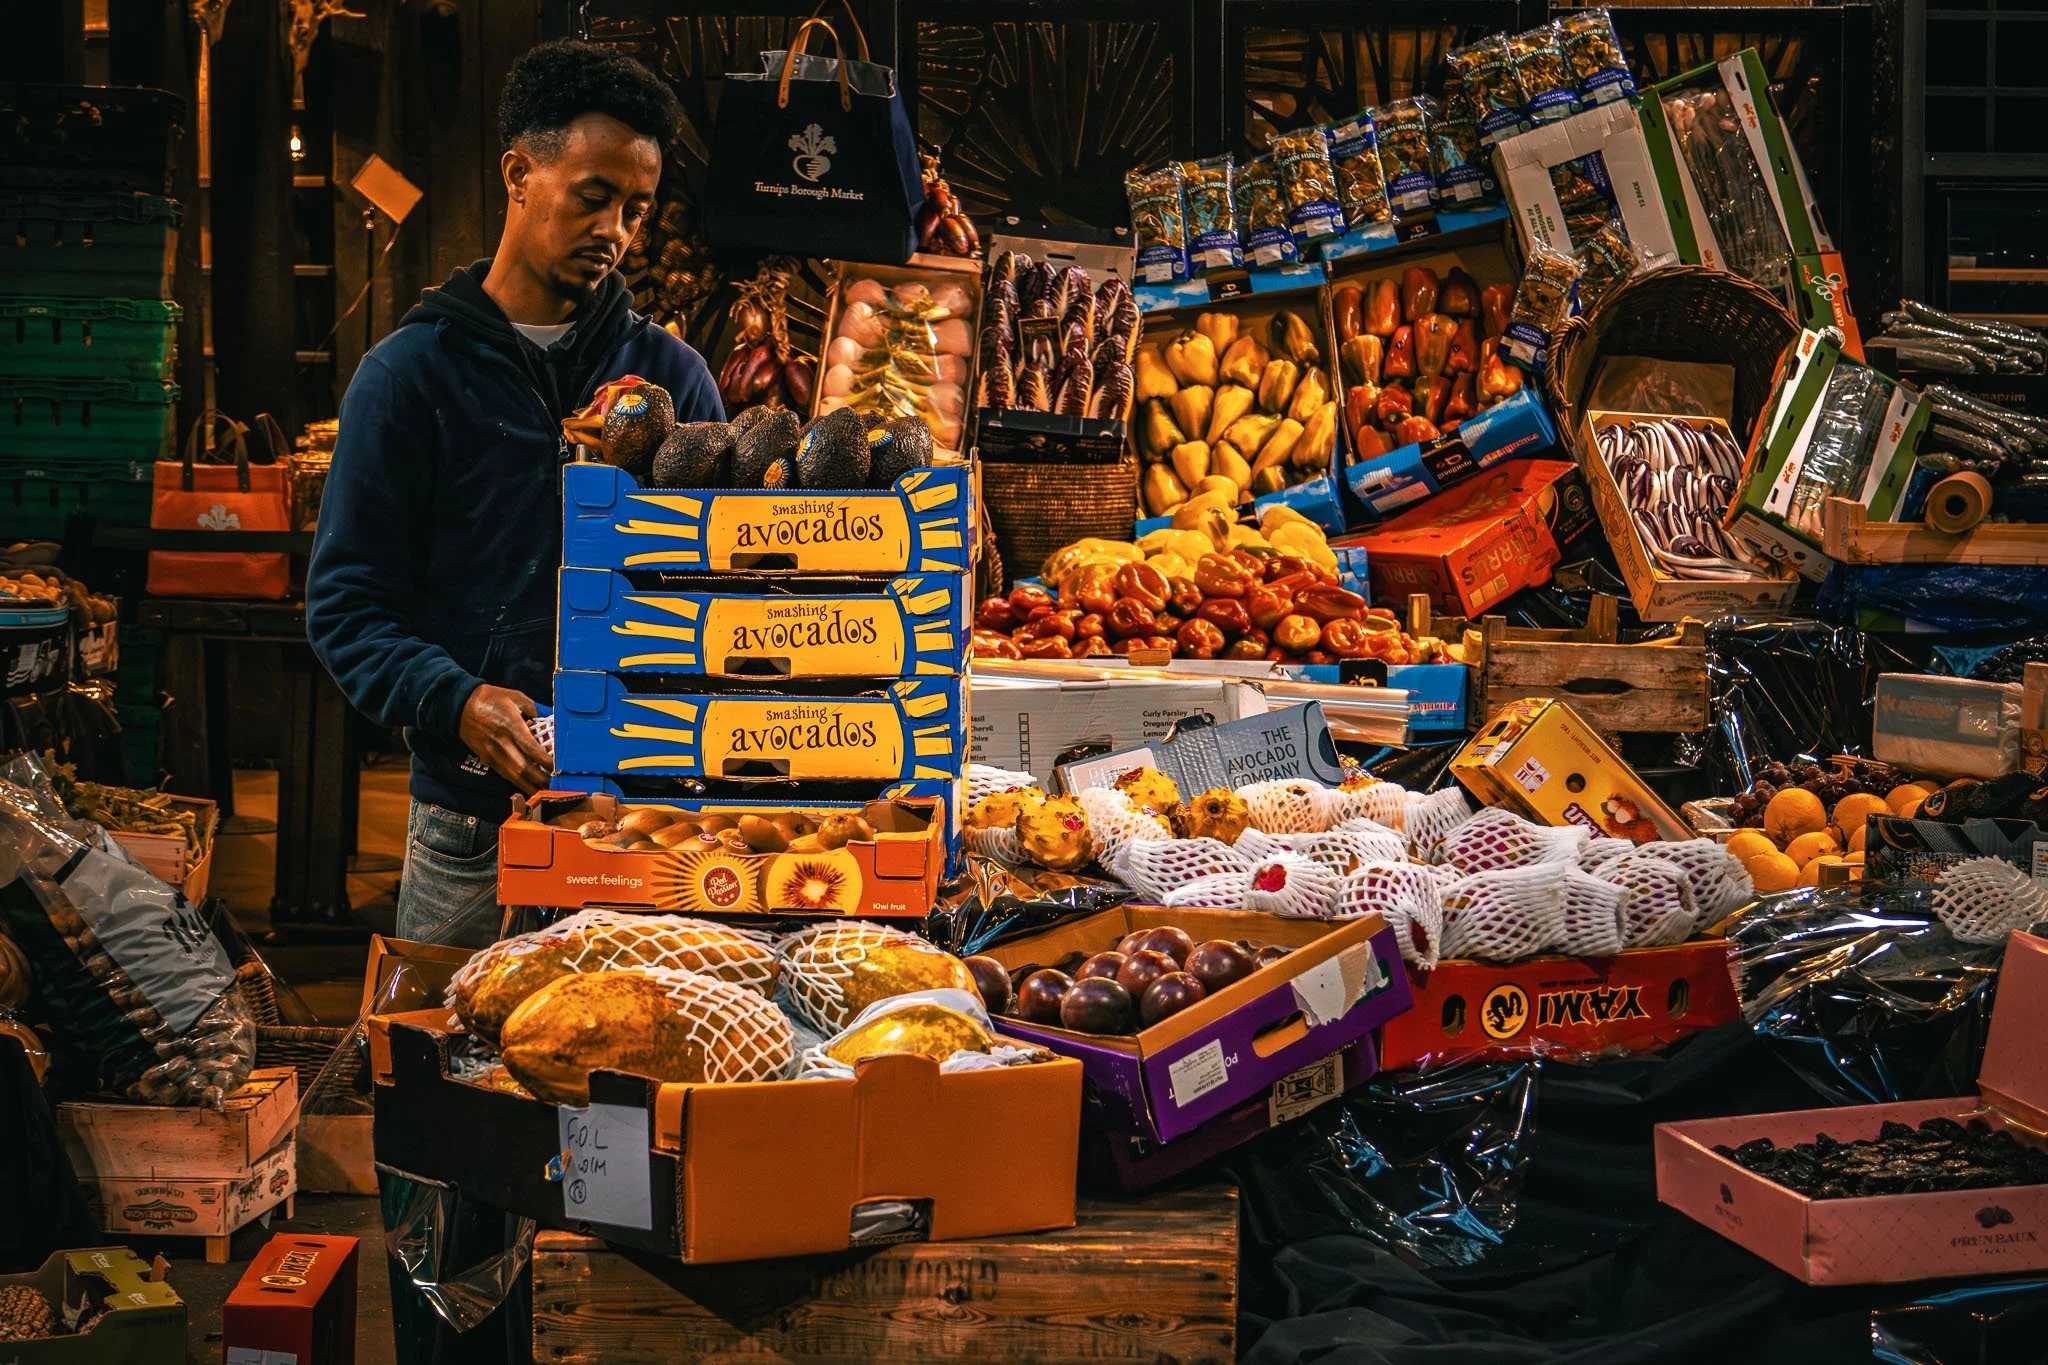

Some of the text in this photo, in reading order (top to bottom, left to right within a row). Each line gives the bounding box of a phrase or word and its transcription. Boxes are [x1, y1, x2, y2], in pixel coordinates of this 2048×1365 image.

[1565, 33, 1583, 45] JOHN
[1378, 126, 1396, 138] JOHN
[754, 181, 864, 200] Turnips Borough Market
[772, 500, 835, 519] smashing
[736, 507, 884, 548] avocados
[767, 603, 829, 622] smashing
[732, 610, 878, 651] avocados
[766, 705, 829, 724] smashing
[1142, 709, 1188, 718] Curly Parsley
[731, 713, 877, 753] avocados
[1143, 720, 1173, 728] Oregano
[1143, 730, 1167, 738] Lemon
[1261, 726, 1291, 745] THE
[1228, 743, 1297, 774] AVOCADO
[566, 873, 643, 888] sweet feelings
[707, 880, 738, 899] Passion
[710, 873, 728, 888] Red
[872, 902, 907, 911] Kiwi fruit
[1536, 985, 1651, 1029] YAMI
[1950, 1231, 2037, 1249] PRUNEAUX
